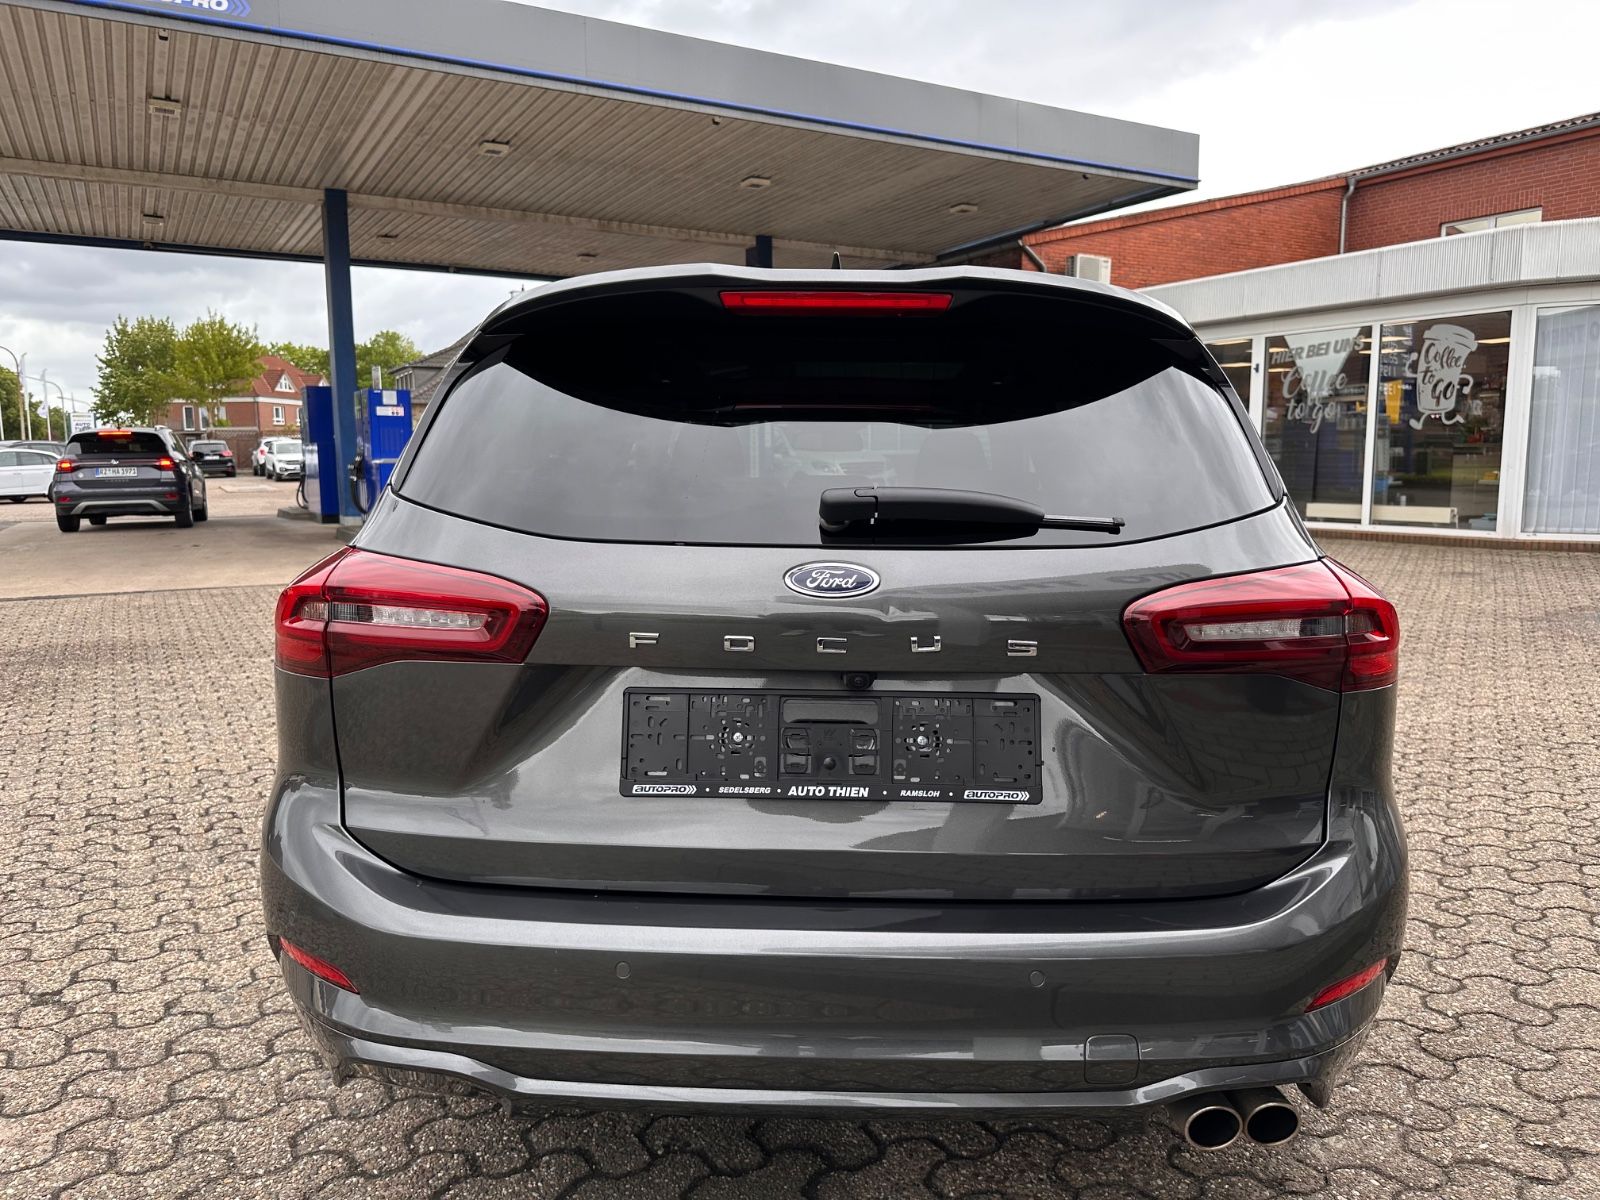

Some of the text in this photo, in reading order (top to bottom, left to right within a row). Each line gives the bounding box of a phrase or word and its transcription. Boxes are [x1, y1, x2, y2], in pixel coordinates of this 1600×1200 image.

[1271, 346, 1305, 364] HIER
[1305, 341, 1331, 359] BEI
[1333, 335, 1366, 354] UNS
[1424, 342, 1462, 369] Coffee
[1420, 366, 1436, 385] to
[1431, 378, 1456, 407] GO
[1286, 398, 1337, 434] to go
[806, 569, 858, 589] Ford
[629, 632, 1039, 657] FOCUS
[718, 786, 772, 794] SEDELSBERG
[788, 785, 825, 796] AUTO
[828, 786, 869, 798] THIEN
[900, 789, 940, 798] RAMSLOH
